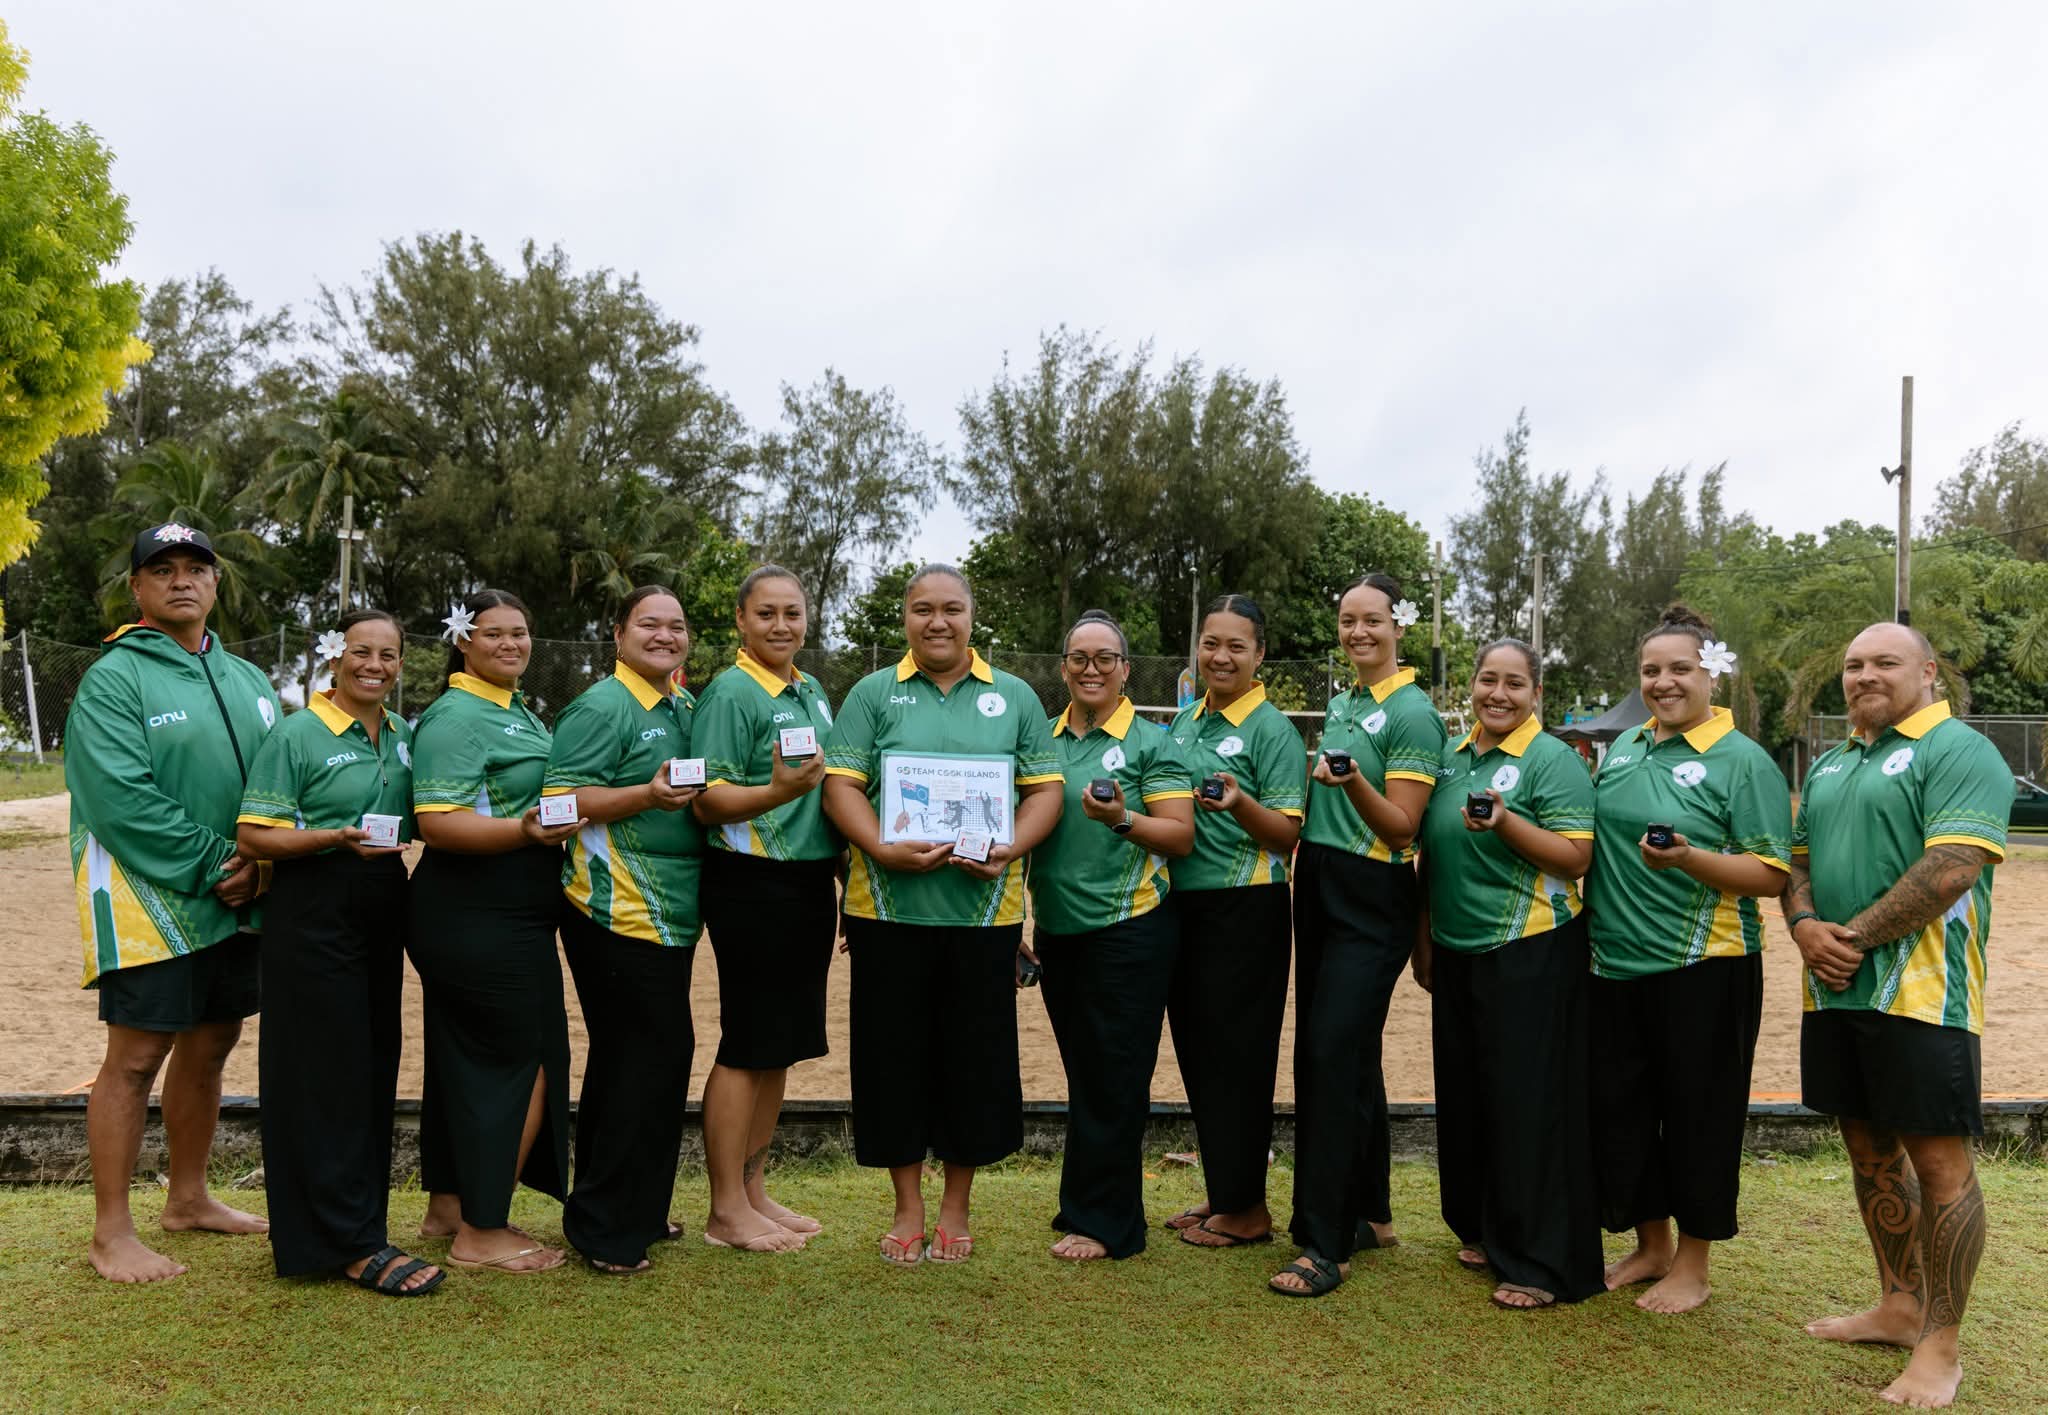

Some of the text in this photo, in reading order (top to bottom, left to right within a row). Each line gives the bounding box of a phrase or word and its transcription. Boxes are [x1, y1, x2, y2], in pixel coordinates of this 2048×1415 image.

[912, 767, 935, 775] TEAM
[937, 769, 962, 777] COOK
[964, 770, 1000, 778] ISLANDS
